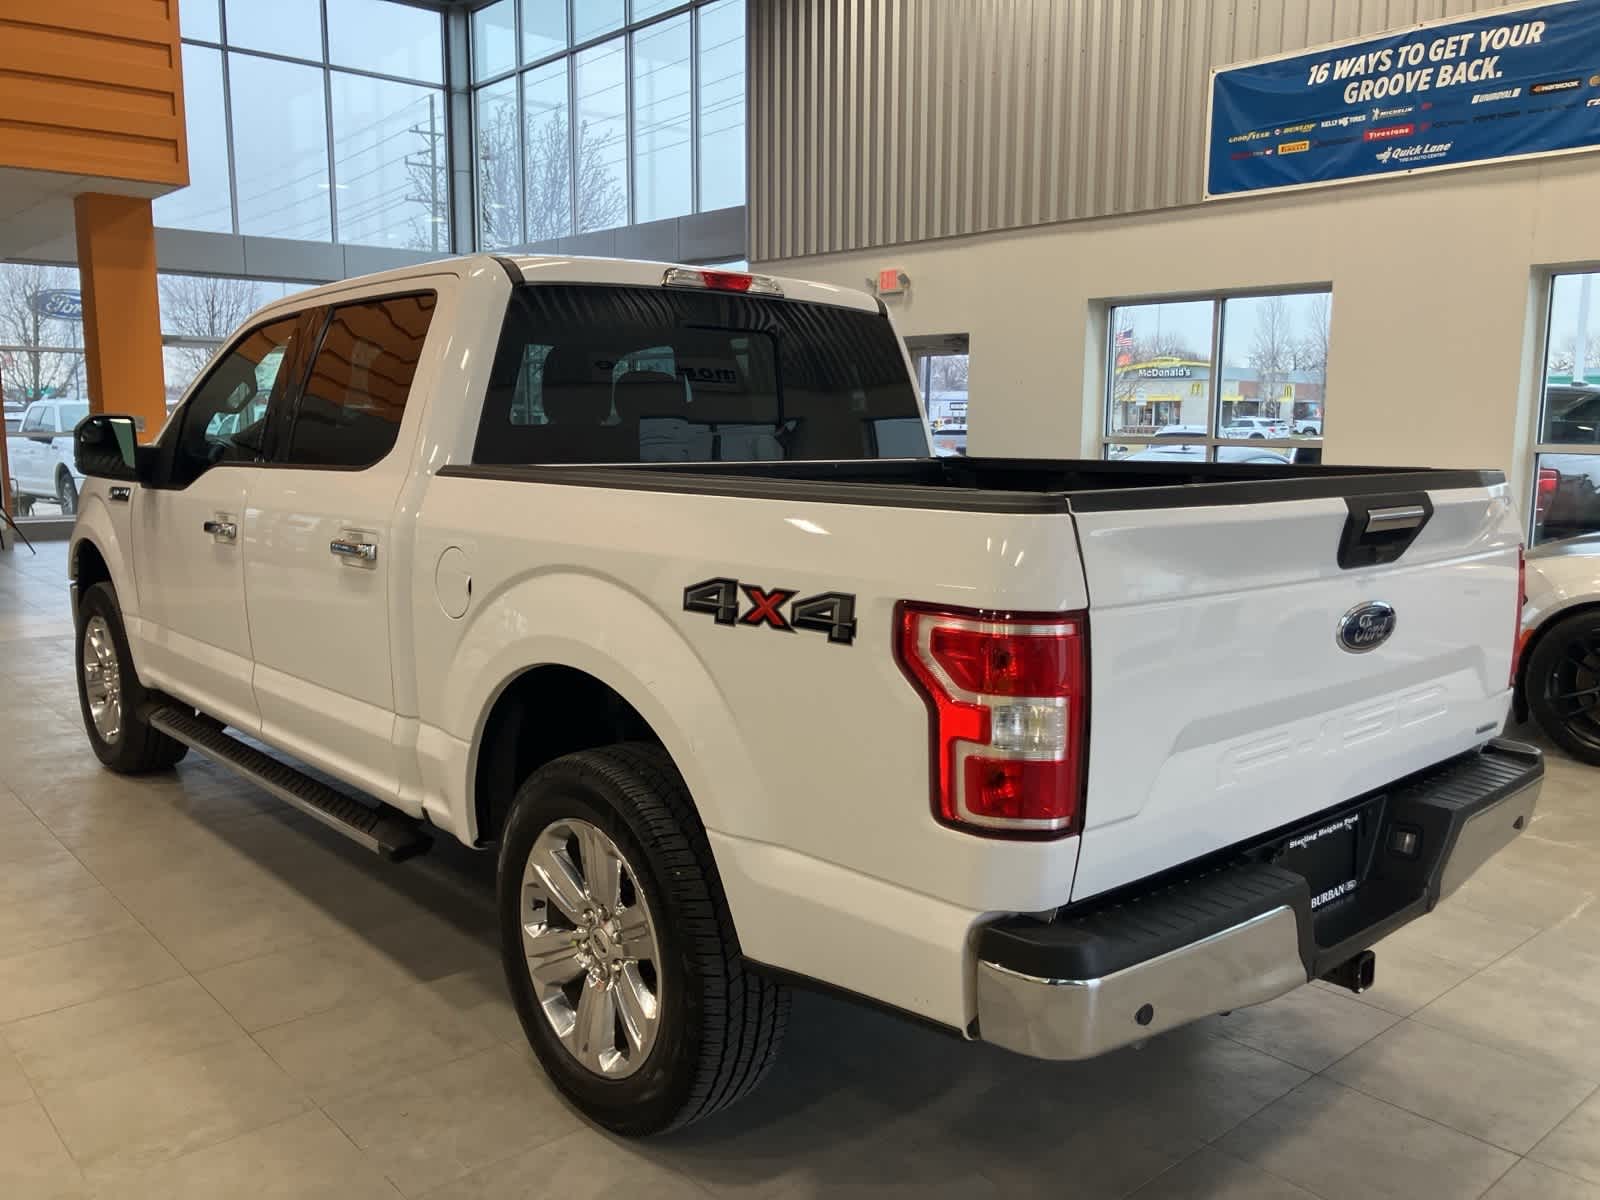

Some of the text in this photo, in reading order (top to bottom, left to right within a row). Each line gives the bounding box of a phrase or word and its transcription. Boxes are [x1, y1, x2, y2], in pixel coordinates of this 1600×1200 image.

[1307, 21, 1547, 86] 16 WAYS TO GET YOUR
[1343, 56, 1503, 104] GROOVE BACK.
[1321, 119, 1338, 128] KELLY
[1228, 130, 1271, 144] GOODYEAR
[1367, 126, 1410, 140] Firestone
[1391, 142, 1453, 159] Quick Lane
[1138, 367, 1191, 378] McDonald's
[1289, 832, 1317, 848] Sterling
